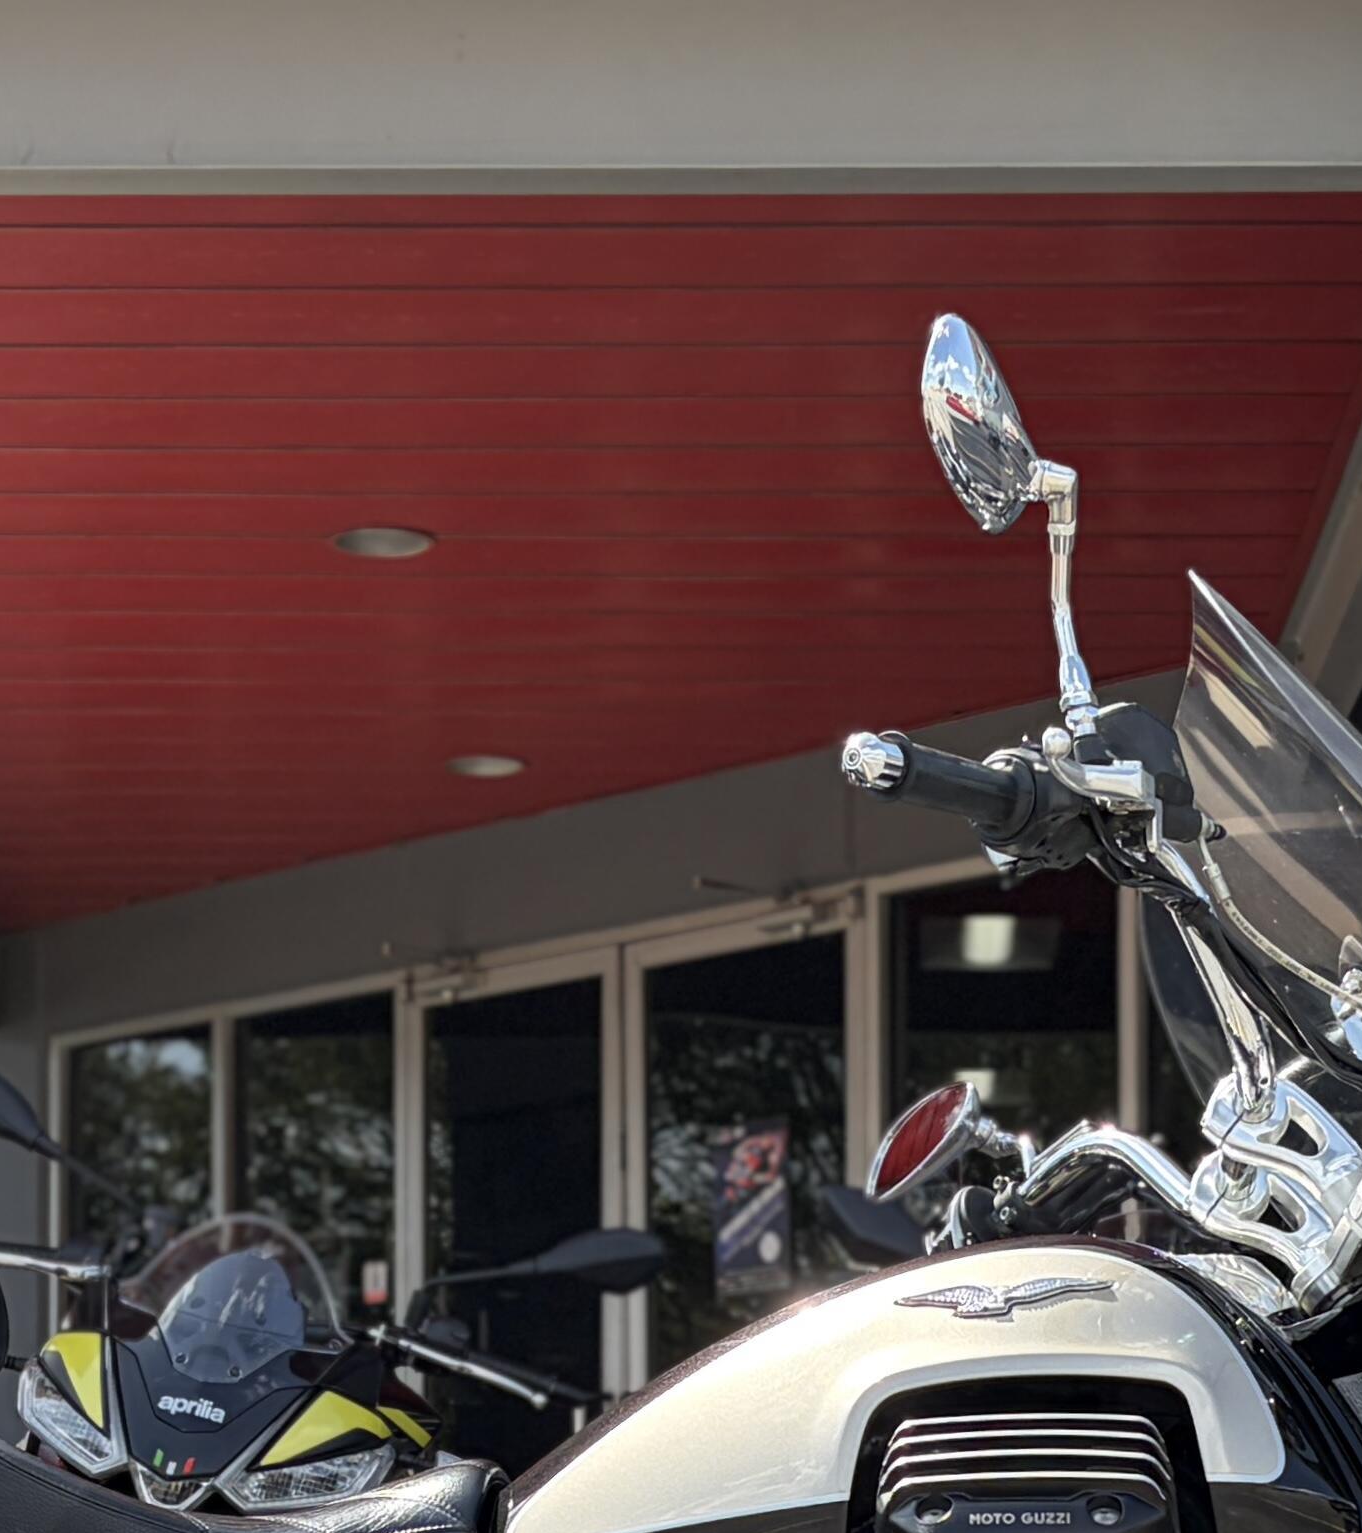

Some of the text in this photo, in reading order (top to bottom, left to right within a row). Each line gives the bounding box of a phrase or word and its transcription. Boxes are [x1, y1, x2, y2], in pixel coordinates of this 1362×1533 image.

[158, 1395, 226, 1424] aprilia
[969, 1512, 1071, 1525] MOTO GUZZI
